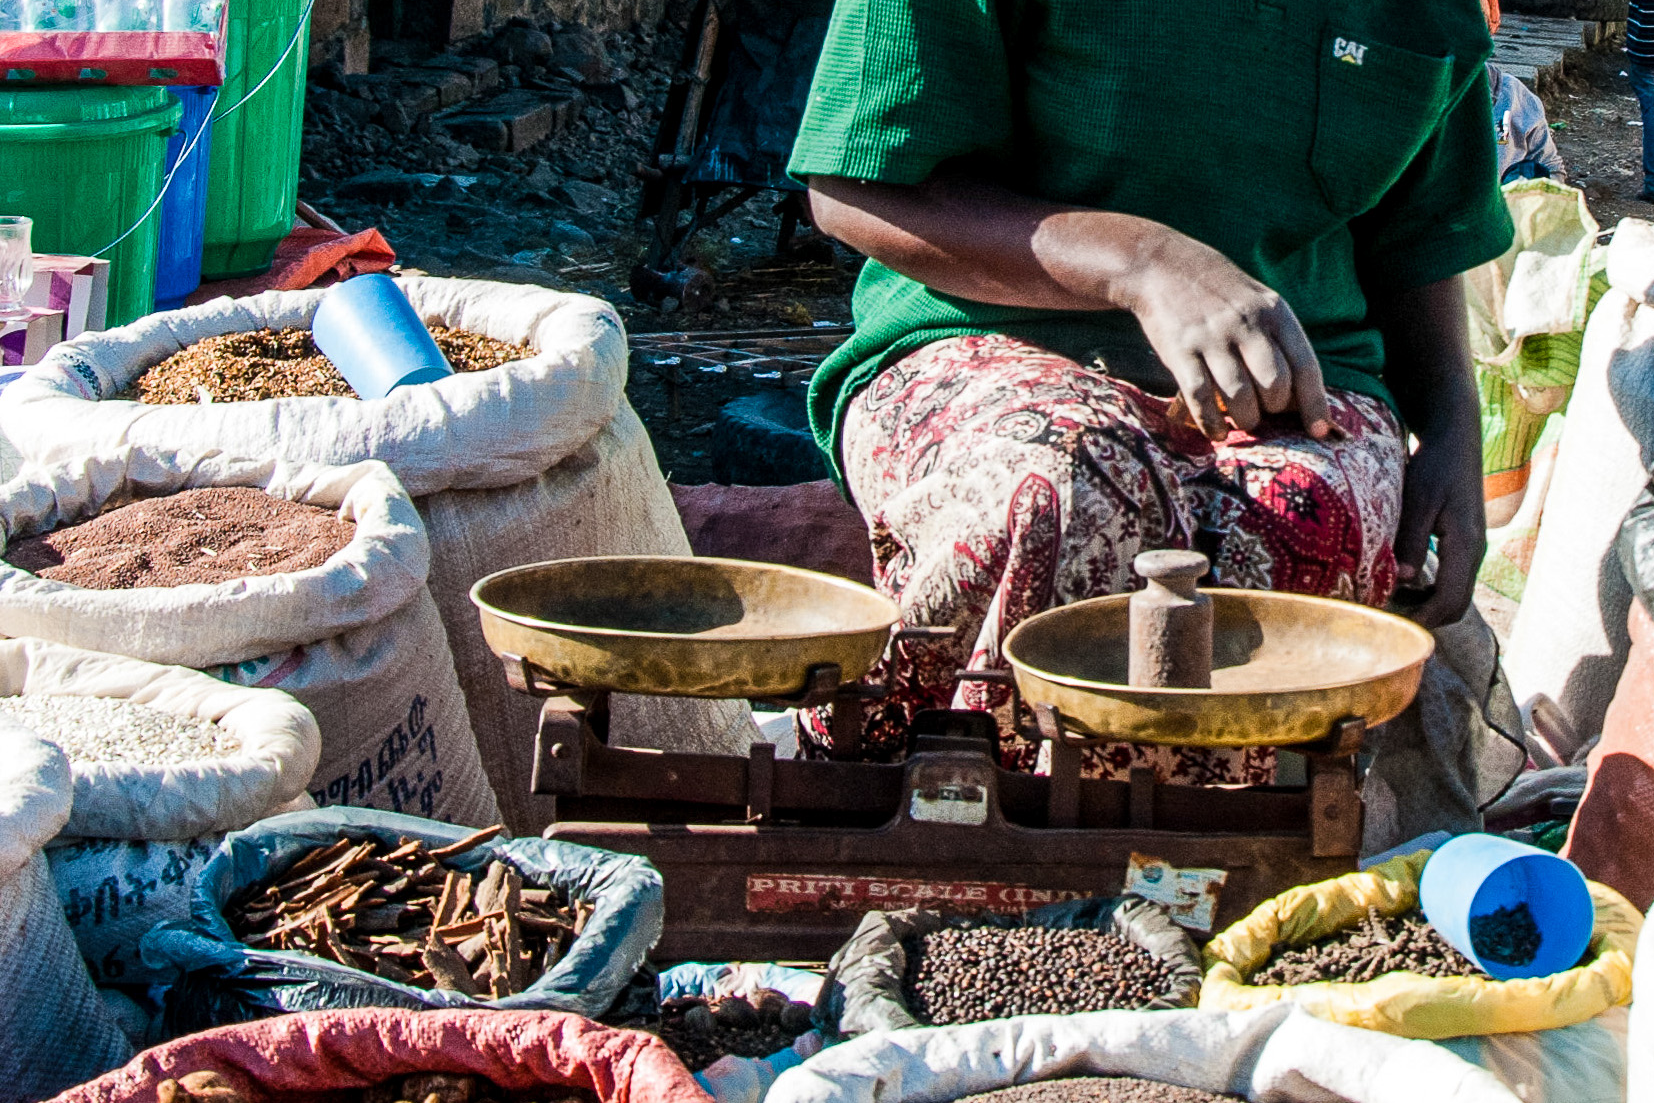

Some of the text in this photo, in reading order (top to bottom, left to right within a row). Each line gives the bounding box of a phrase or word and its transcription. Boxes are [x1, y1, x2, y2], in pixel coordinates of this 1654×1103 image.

[1333, 37, 1369, 66] CAT
[751, 878, 856, 896] PRITI
[868, 883, 987, 900] SCALE
